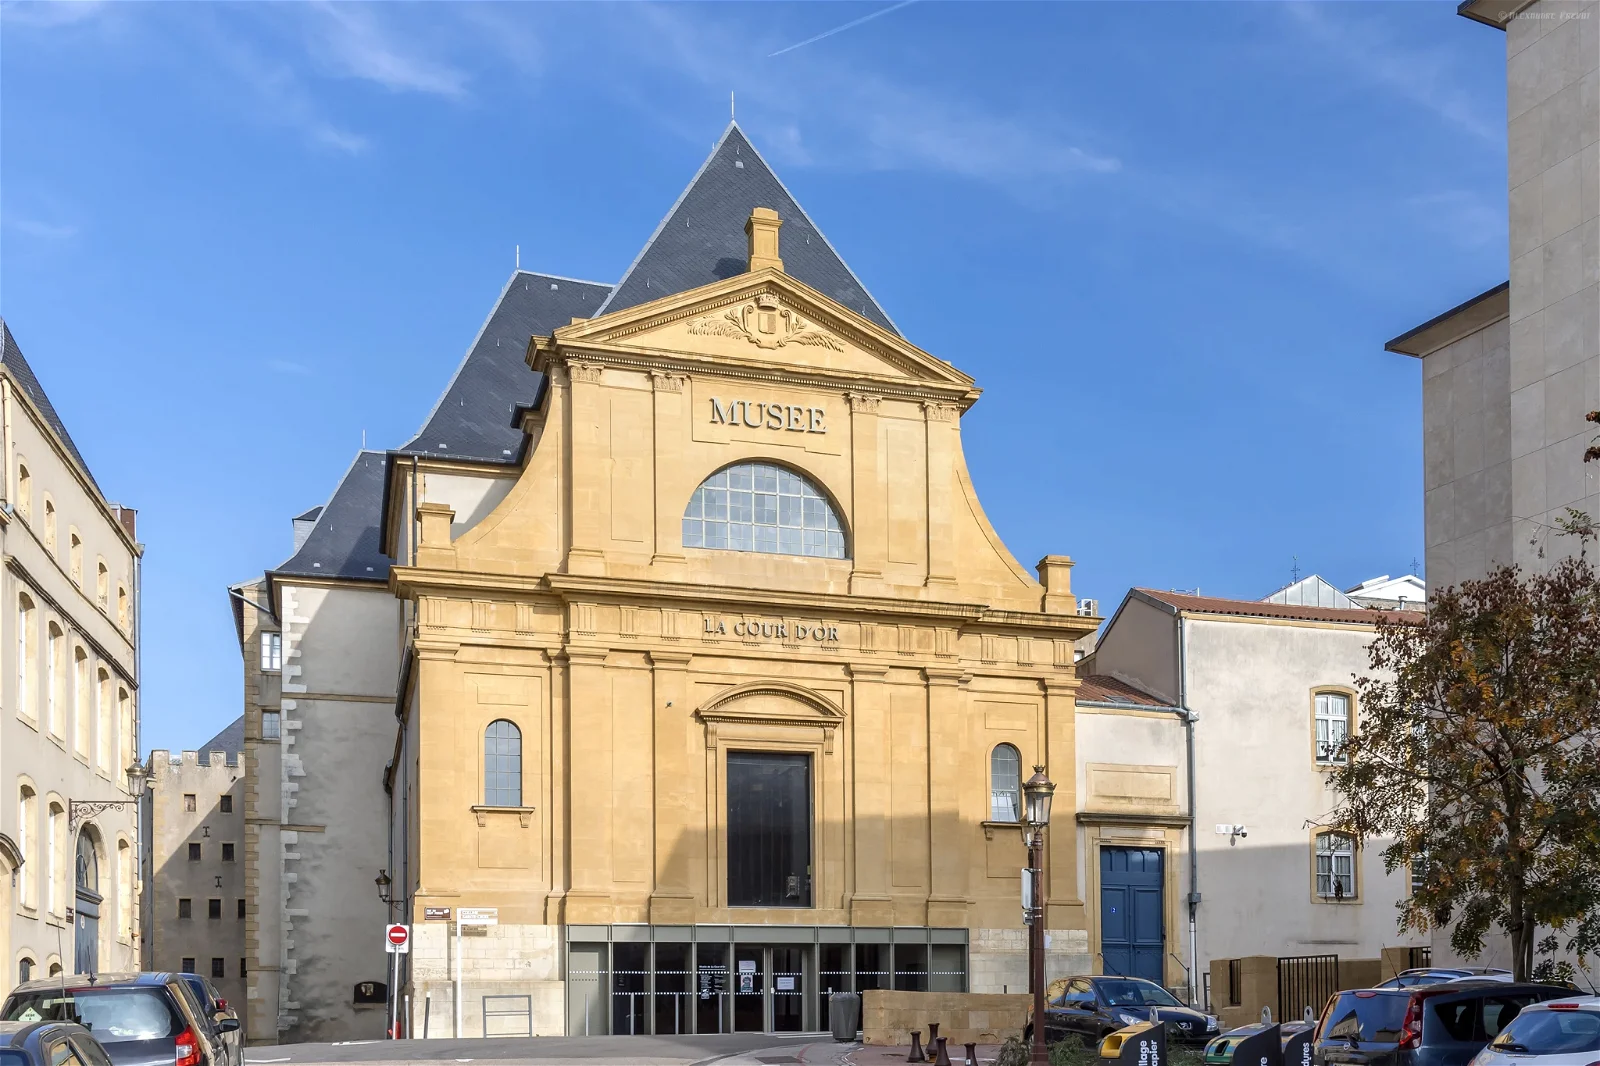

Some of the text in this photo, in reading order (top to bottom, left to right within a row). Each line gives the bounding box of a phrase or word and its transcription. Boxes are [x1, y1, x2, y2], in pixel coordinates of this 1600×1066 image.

[709, 396, 827, 434] MUSEE
[704, 618, 726, 635] LA
[734, 621, 788, 638] COUR
